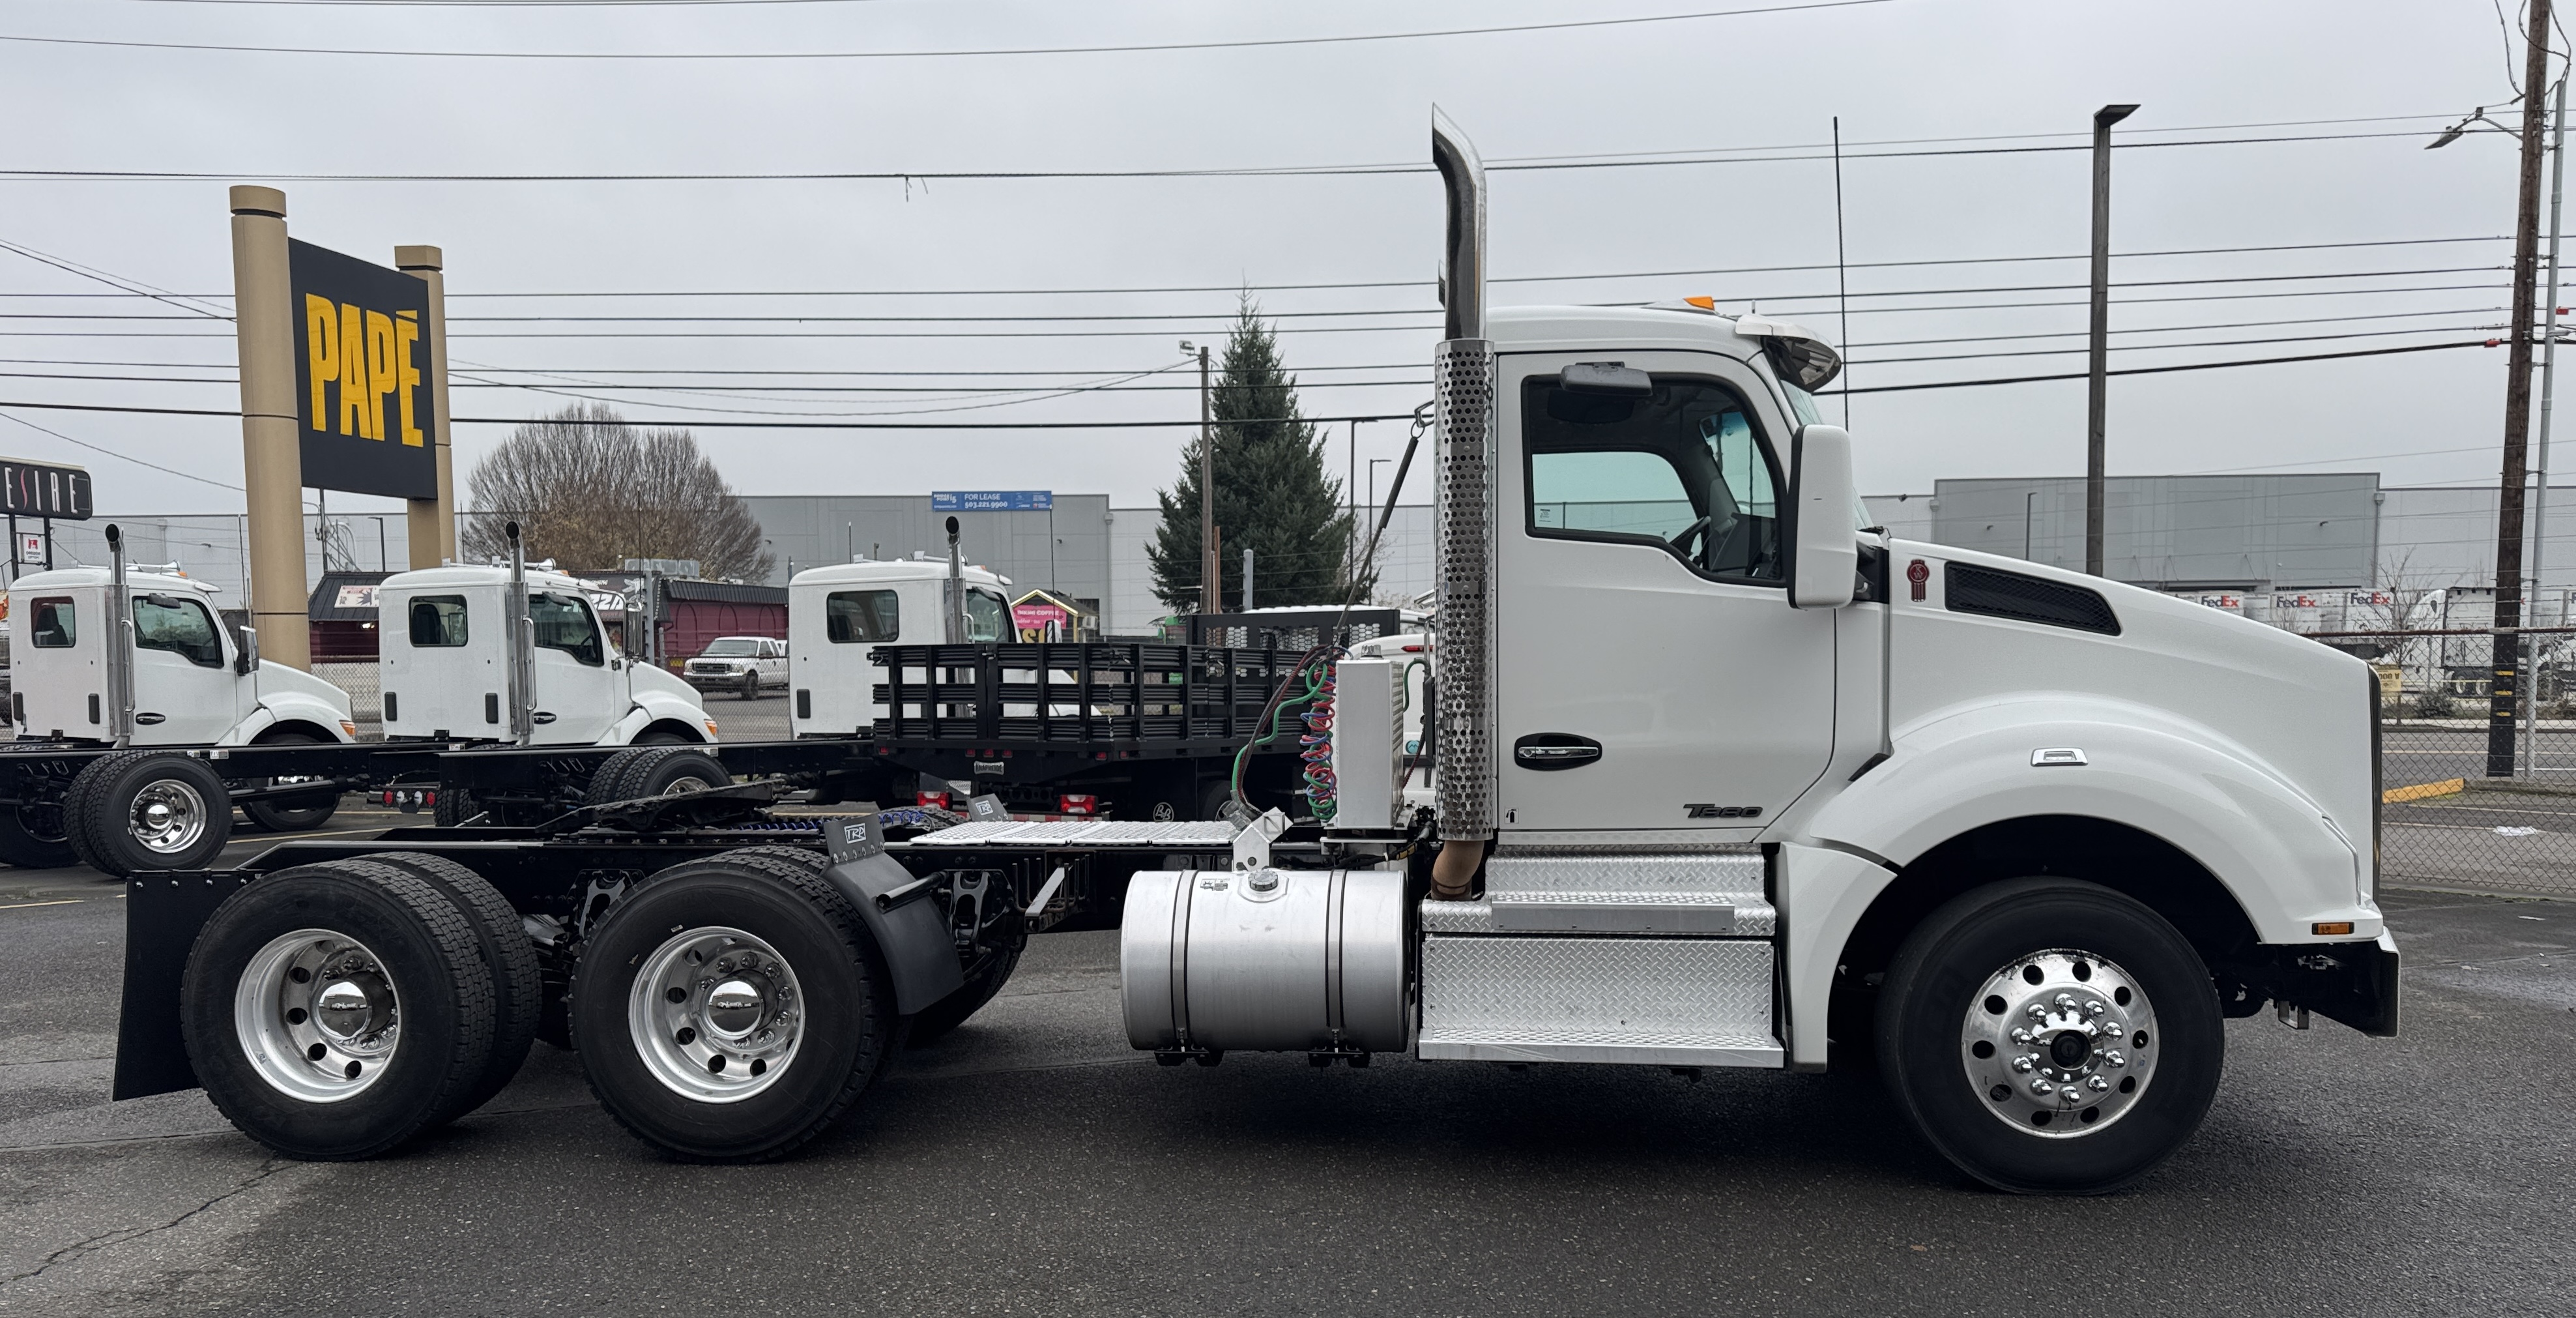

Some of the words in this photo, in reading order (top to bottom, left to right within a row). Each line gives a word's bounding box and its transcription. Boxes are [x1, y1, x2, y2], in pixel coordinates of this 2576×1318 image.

[305, 293, 424, 448] PAPÉ
[4, 467, 78, 514] ESIRE
[590, 593, 624, 611] ZZA
[2201, 595, 2239, 608] FedEx
[2276, 596, 2316, 608] FedEx
[2351, 592, 2390, 605] FedEx
[1683, 804, 1763, 818] T880
[846, 827, 865, 840] TRP
